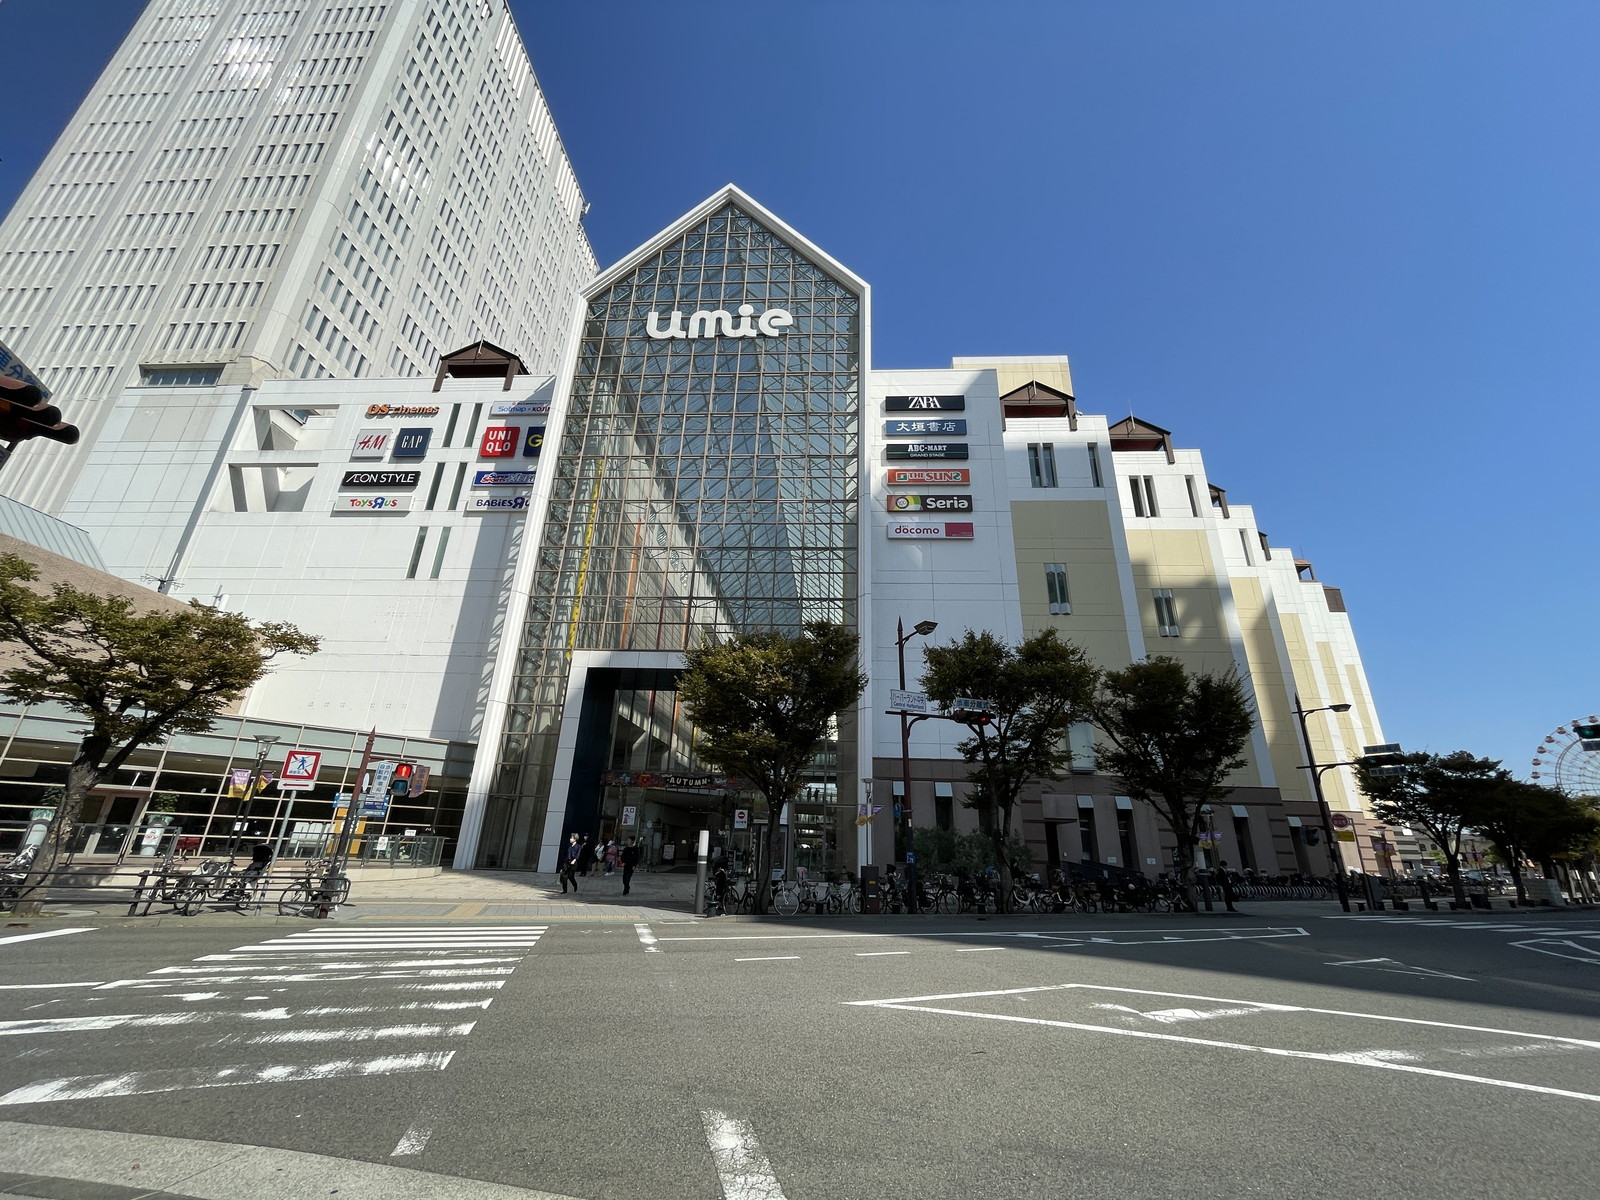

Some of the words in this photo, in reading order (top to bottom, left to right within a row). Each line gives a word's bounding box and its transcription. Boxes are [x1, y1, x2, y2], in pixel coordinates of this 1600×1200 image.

[646, 304, 793, 339] umie
[908, 396, 942, 408] ZARA
[393, 405, 440, 414] cinemas
[896, 422, 956, 432] 大垣書店
[488, 430, 512, 440] UNI
[356, 435, 388, 450] H&M
[402, 435, 423, 448] GAP
[486, 442, 511, 453] QLO
[380, 474, 415, 483] STYLE
[926, 497, 968, 508] Seria
[895, 525, 940, 534] docomo
[670, 777, 708, 786] AUTUMN
